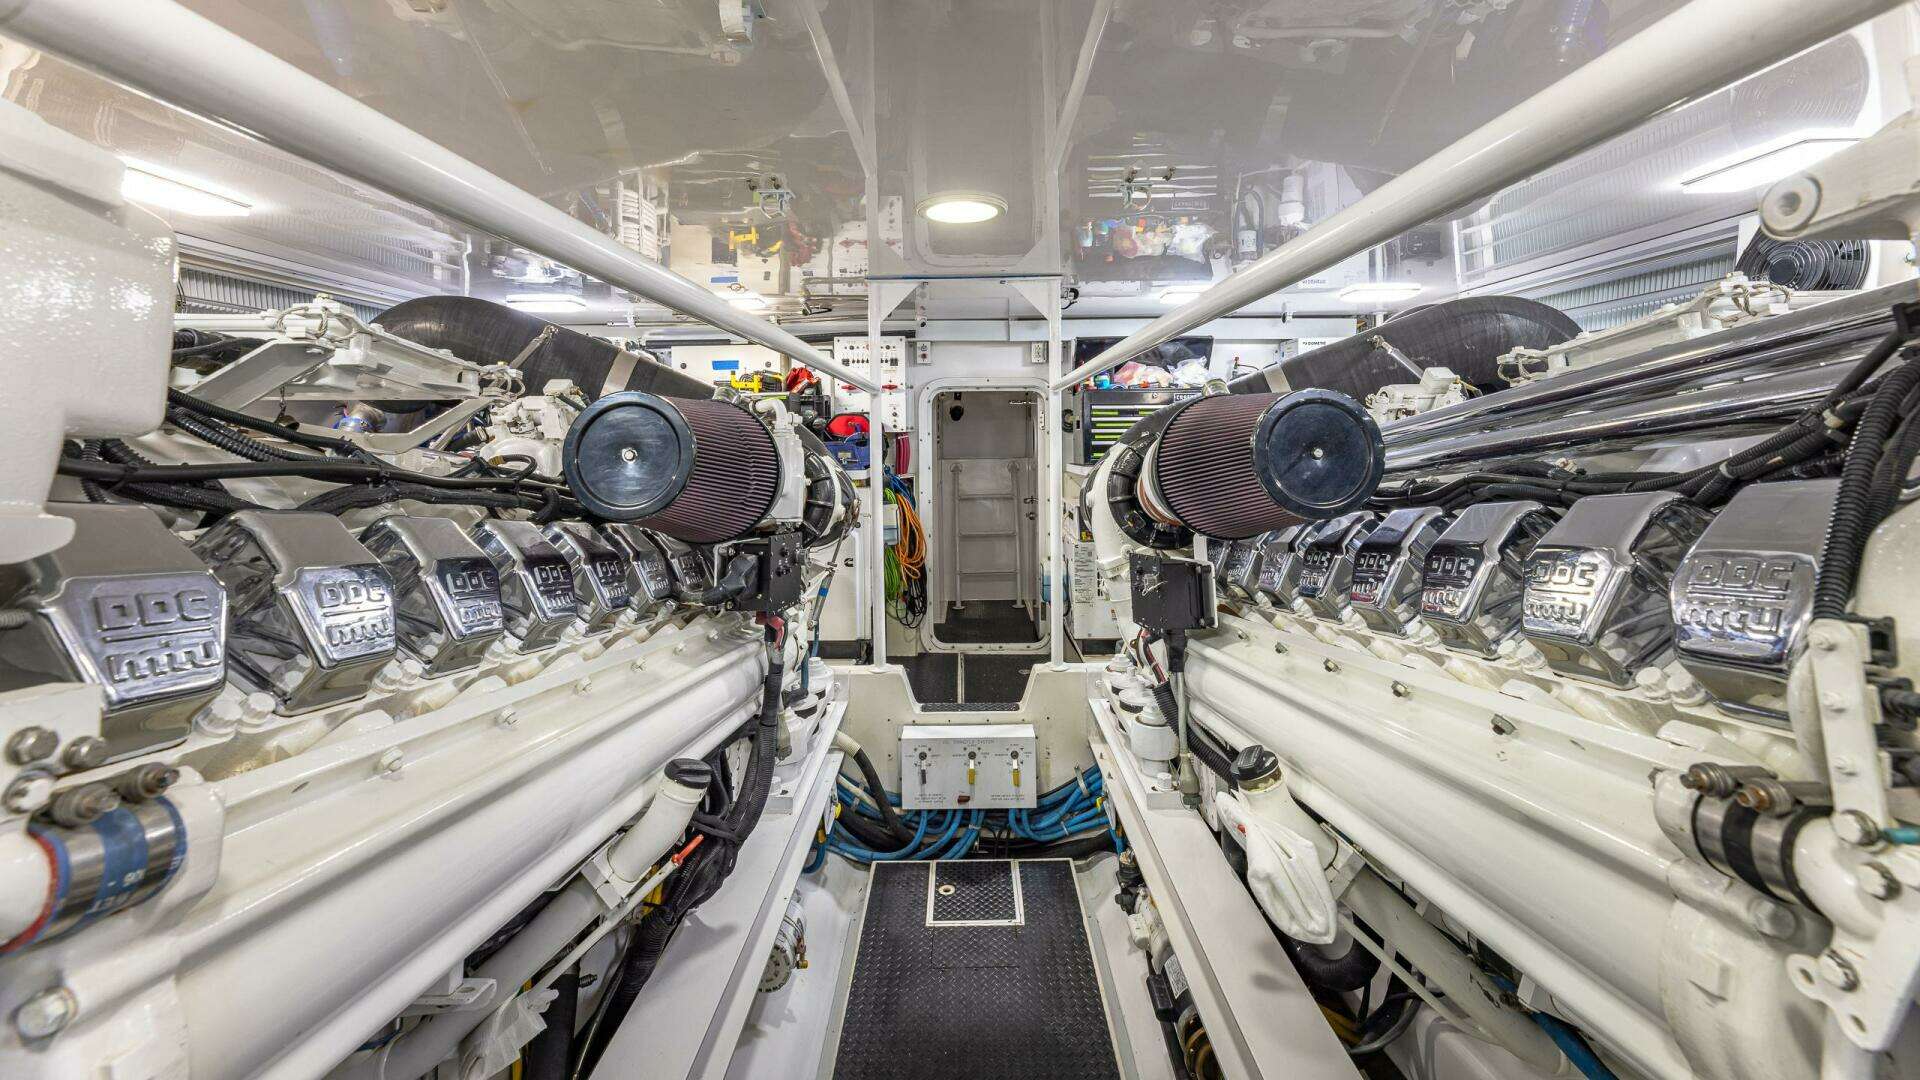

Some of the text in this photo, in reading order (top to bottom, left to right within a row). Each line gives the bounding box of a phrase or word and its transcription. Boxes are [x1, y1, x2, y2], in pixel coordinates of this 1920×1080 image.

[1356, 552, 1392, 572] DDC
[1424, 556, 1475, 580] DDC
[1530, 561, 1599, 587] DDC
[1689, 558, 1796, 592] DDC
[315, 580, 389, 608] DDC
[92, 589, 210, 631] DDC
